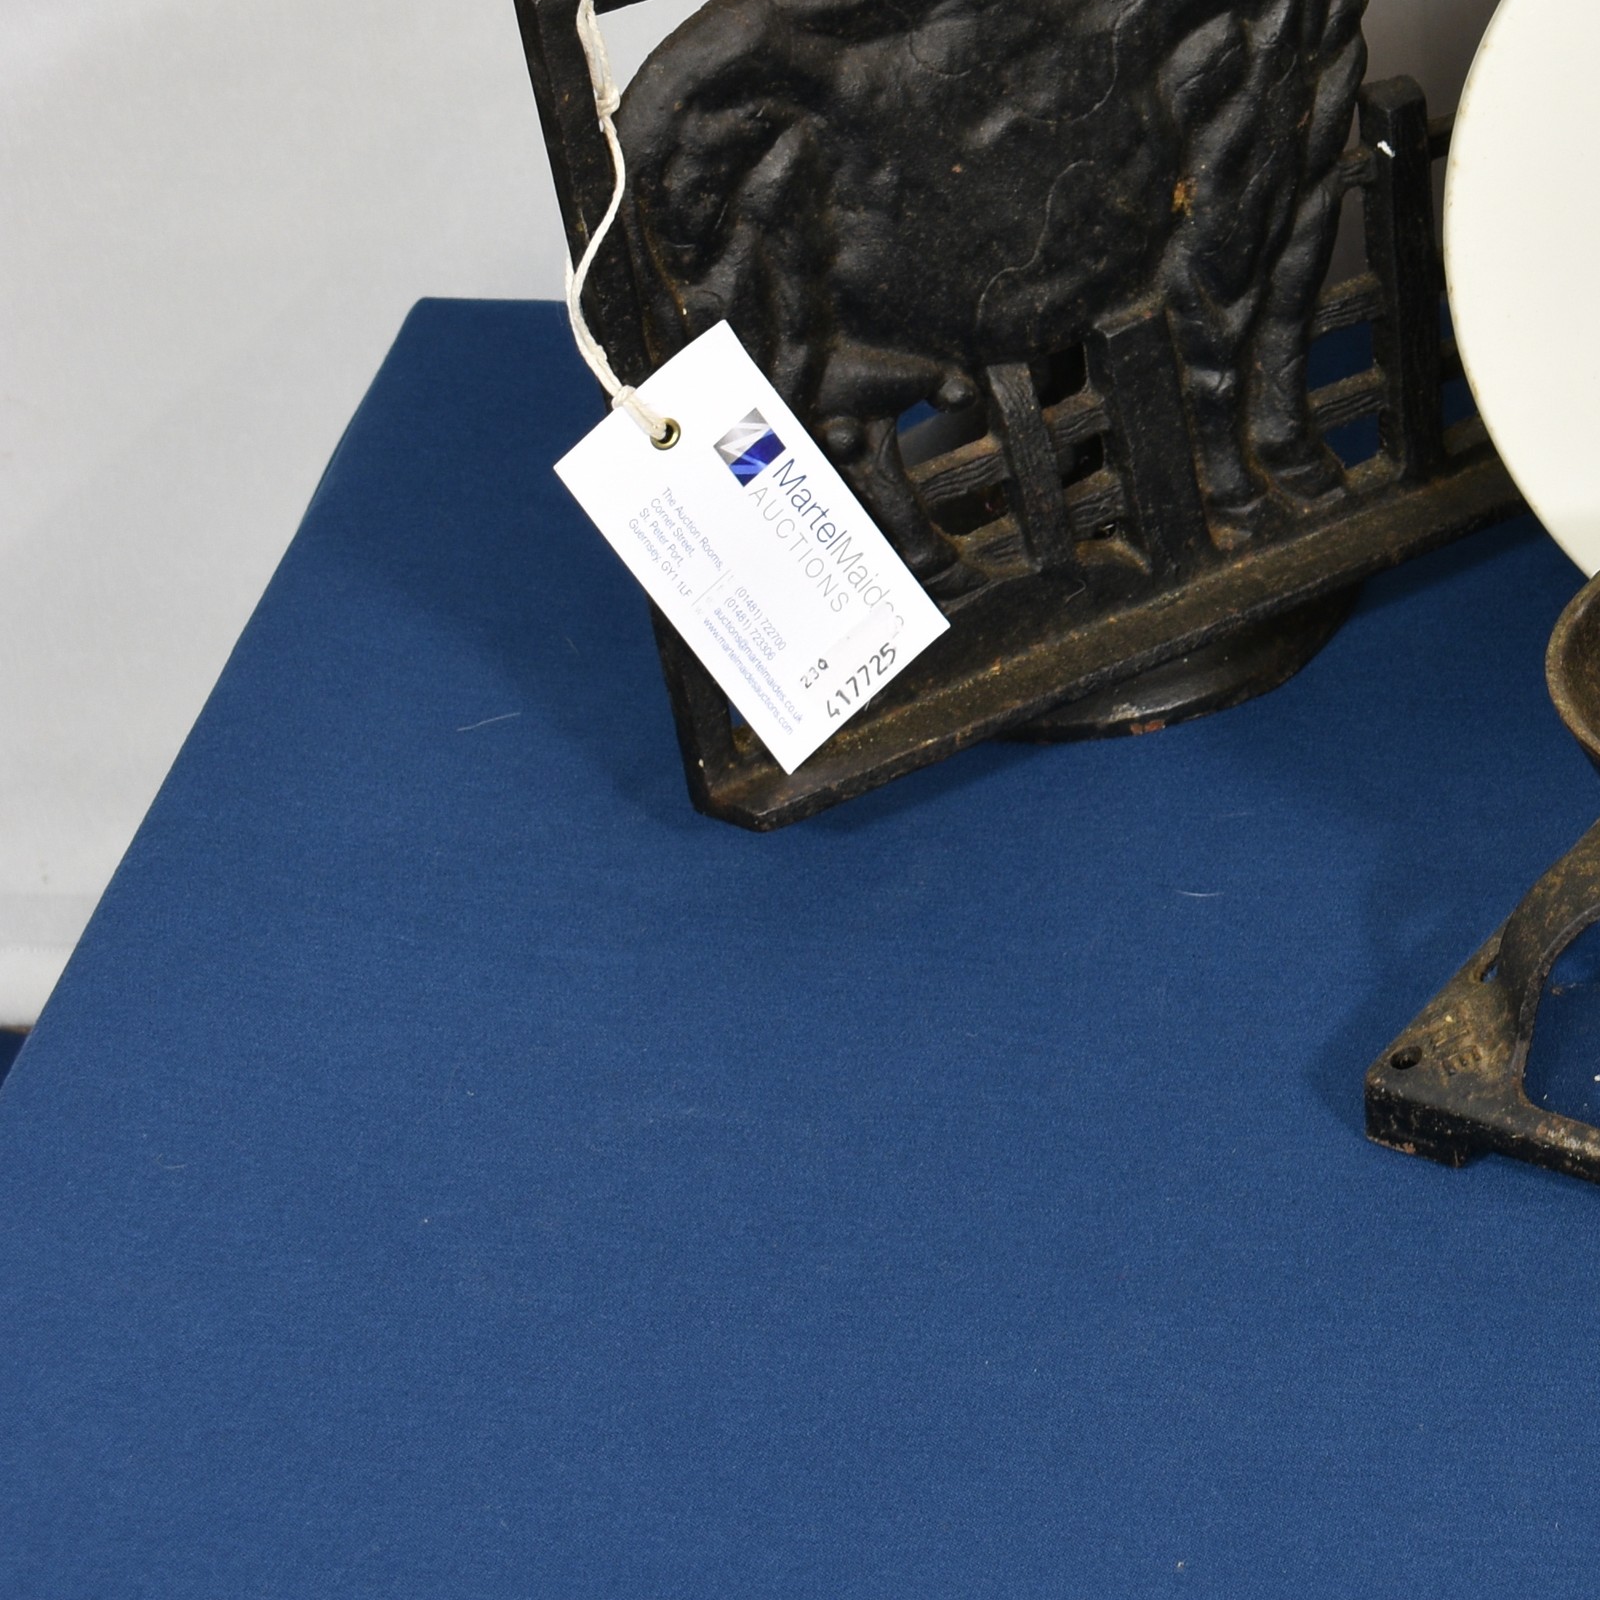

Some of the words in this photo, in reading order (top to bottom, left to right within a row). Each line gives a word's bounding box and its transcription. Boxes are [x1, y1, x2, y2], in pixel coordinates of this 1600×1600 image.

[628, 518, 662, 564] Guernsey,
[660, 560, 679, 582] GY1
[676, 580, 693, 597] 1LF
[648, 520, 670, 545] Peter
[666, 544, 684, 569] Port,
[650, 497, 676, 530] Cornet
[672, 526, 696, 559] Street,
[661, 486, 677, 508] The
[673, 505, 702, 540] Auction
[698, 536, 724, 572] Rooms,
[747, 486, 850, 613] AUCTIONS
[771, 457, 905, 640] MartelMaid
[723, 595, 753, 631] (01481)
[749, 627, 777, 661] 723306
[734, 585, 764, 622] (01481)
[759, 617, 787, 652] 722700
[825, 641, 897, 720] 417725
